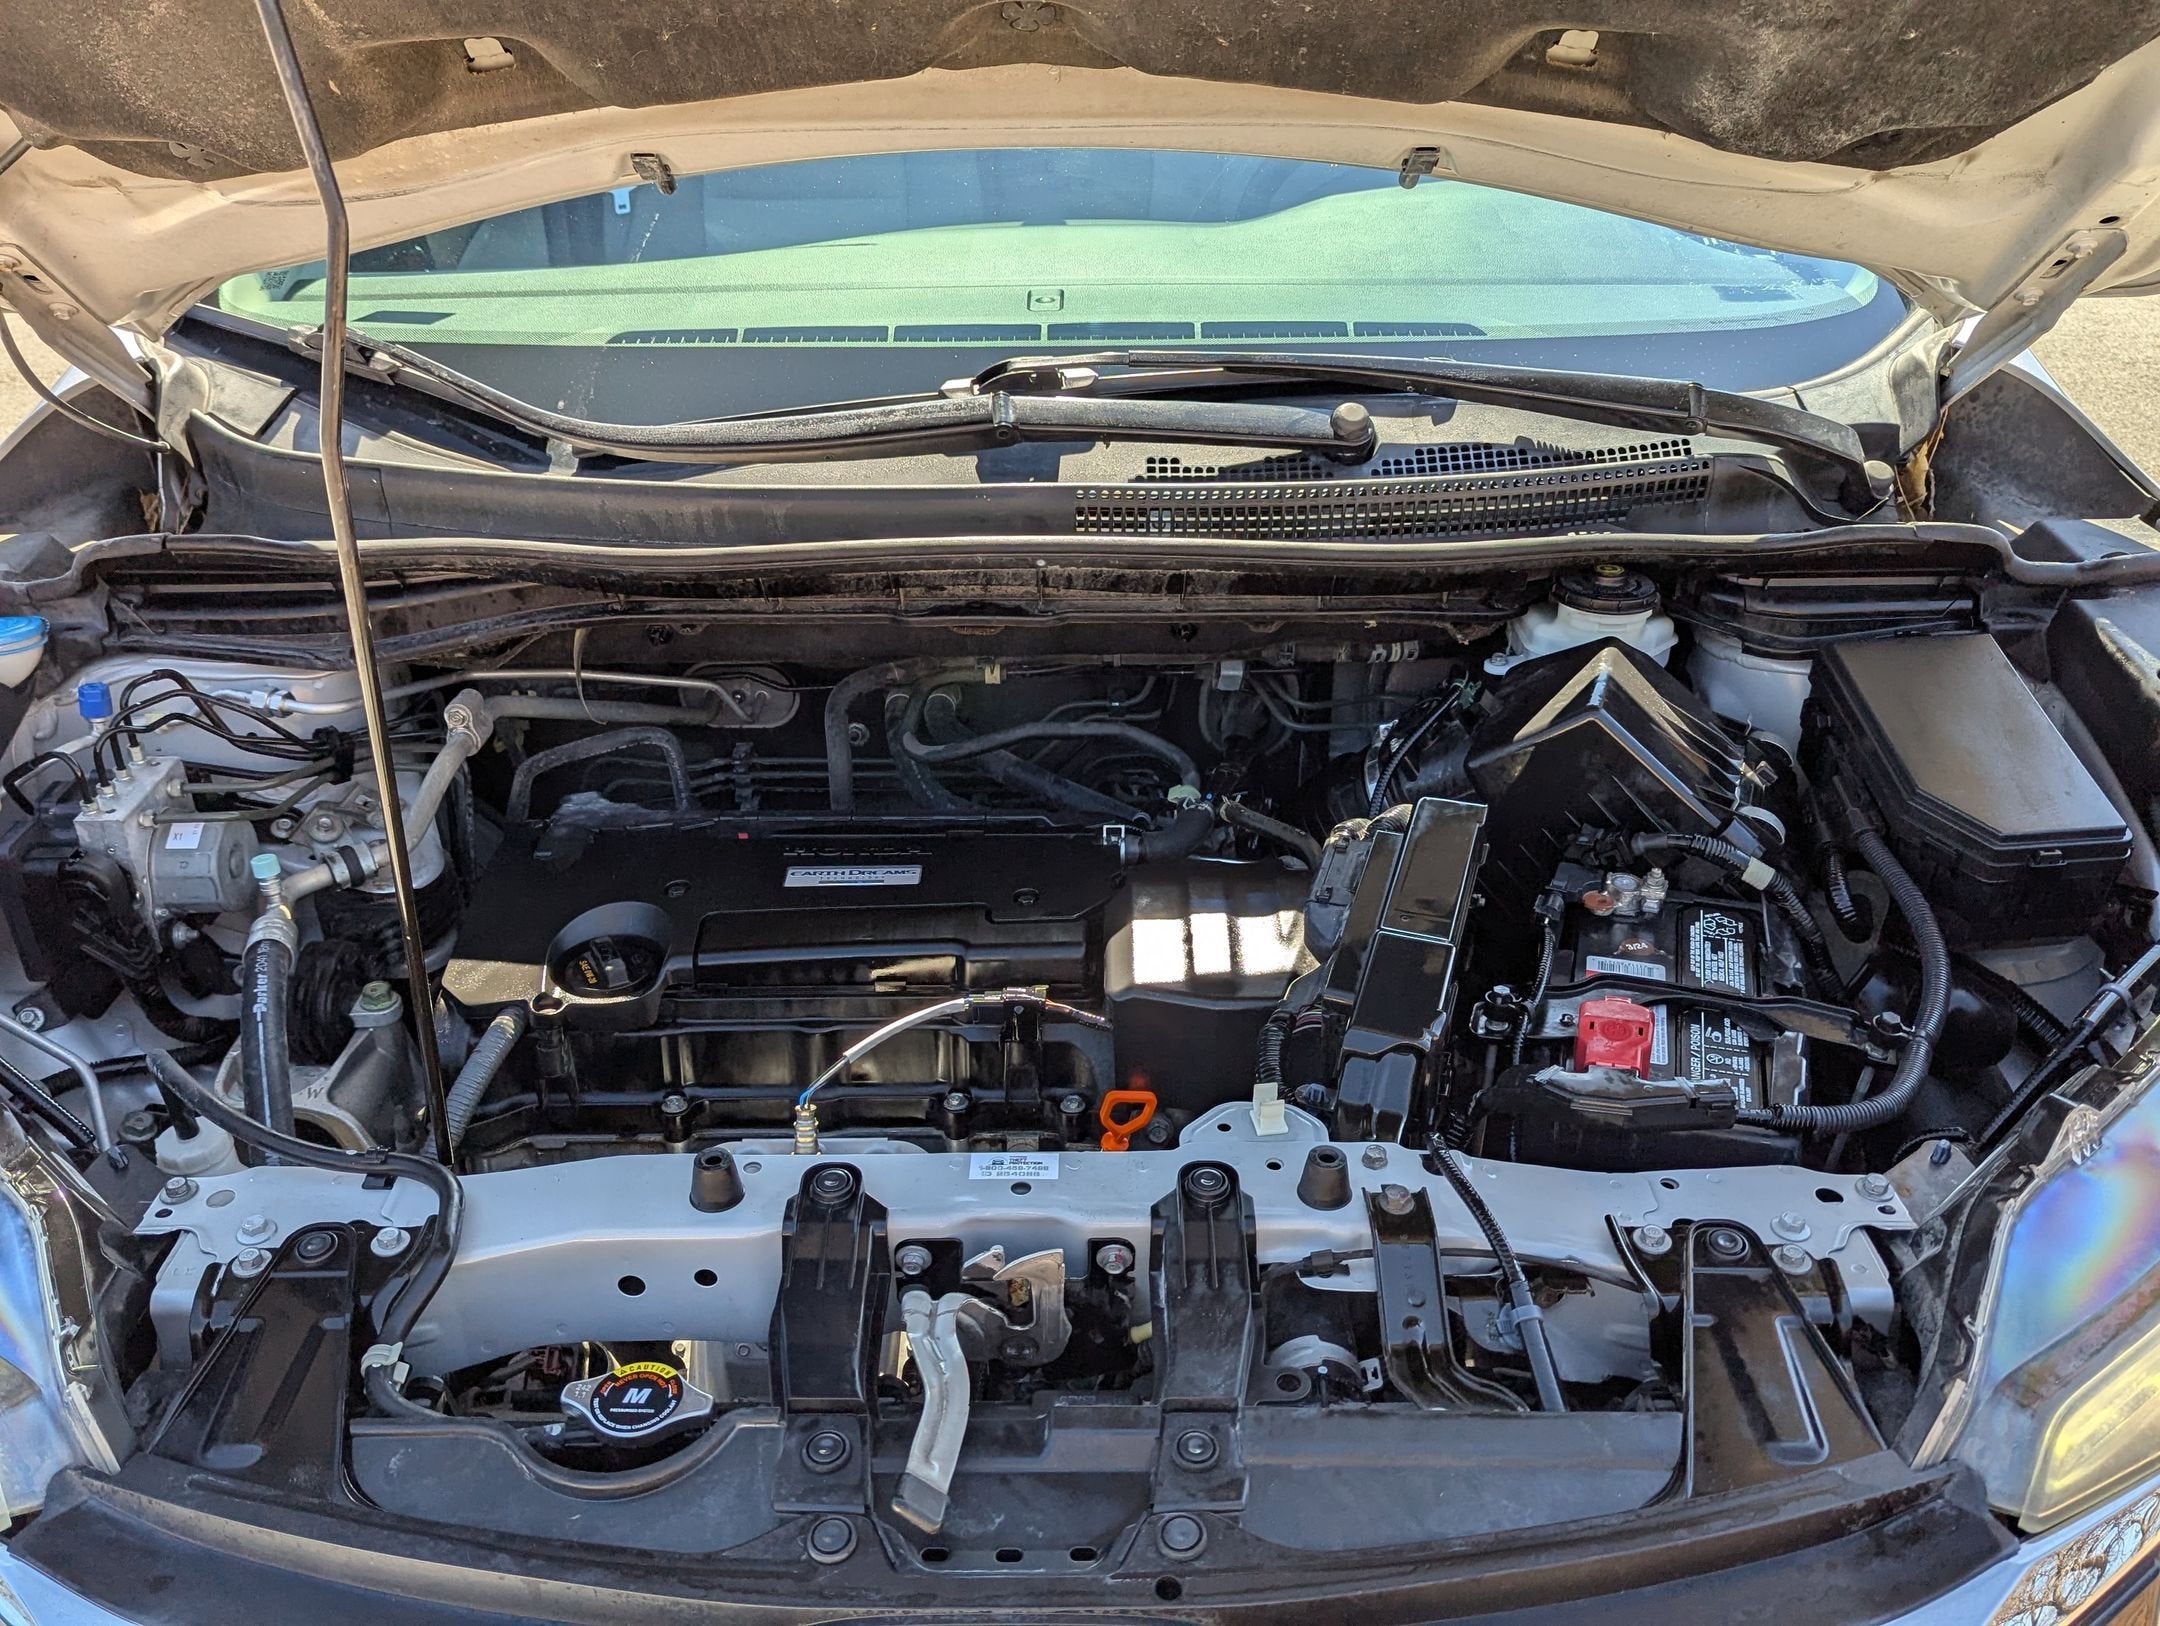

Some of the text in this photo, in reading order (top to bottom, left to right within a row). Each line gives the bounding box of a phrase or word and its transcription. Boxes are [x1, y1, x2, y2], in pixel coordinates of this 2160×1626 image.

[252, 974, 268, 1014] Parker
[1690, 1024, 1700, 1051] POISON
[1690, 1057, 1700, 1080] NGER
[629, 1364, 672, 1376] CAUTION
[615, 1374, 638, 1387] NEVER
[621, 1388, 652, 1404] M
